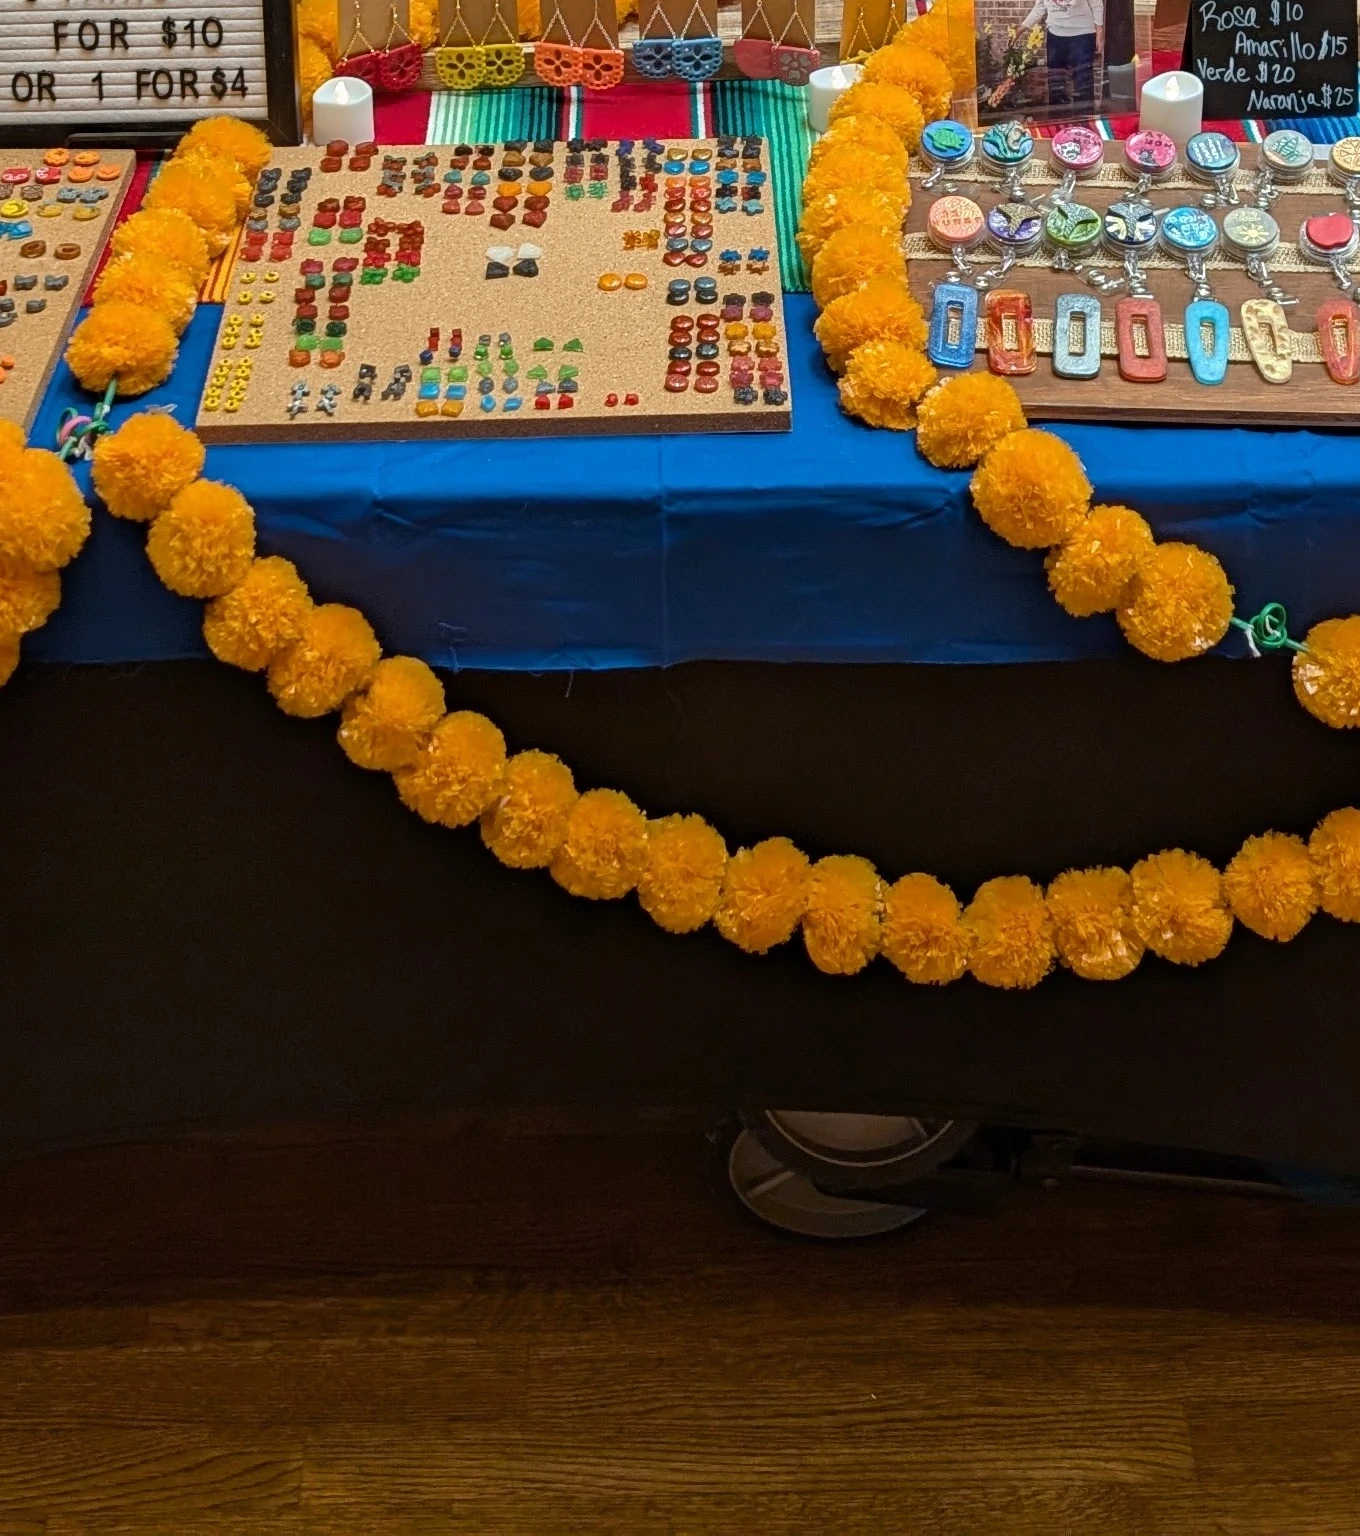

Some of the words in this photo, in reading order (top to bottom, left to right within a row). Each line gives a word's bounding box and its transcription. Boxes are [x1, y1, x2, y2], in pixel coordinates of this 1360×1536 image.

[1198, 0, 1261, 32] Rosa
[52, 17, 129, 52] FOR
[161, 16, 224, 49] $10
[1234, 30, 1316, 63] Amarillo
[1317, 29, 1348, 61] $15
[10, 69, 58, 104] OR
[91, 70, 105, 101] 1
[135, 68, 200, 101] FOR
[210, 66, 249, 101] $4
[1197, 56, 1251, 83] Verde
[1255, 60, 1296, 84] $20
[1246, 88, 1322, 114] Naranja
[1320, 82, 1355, 110] $25
